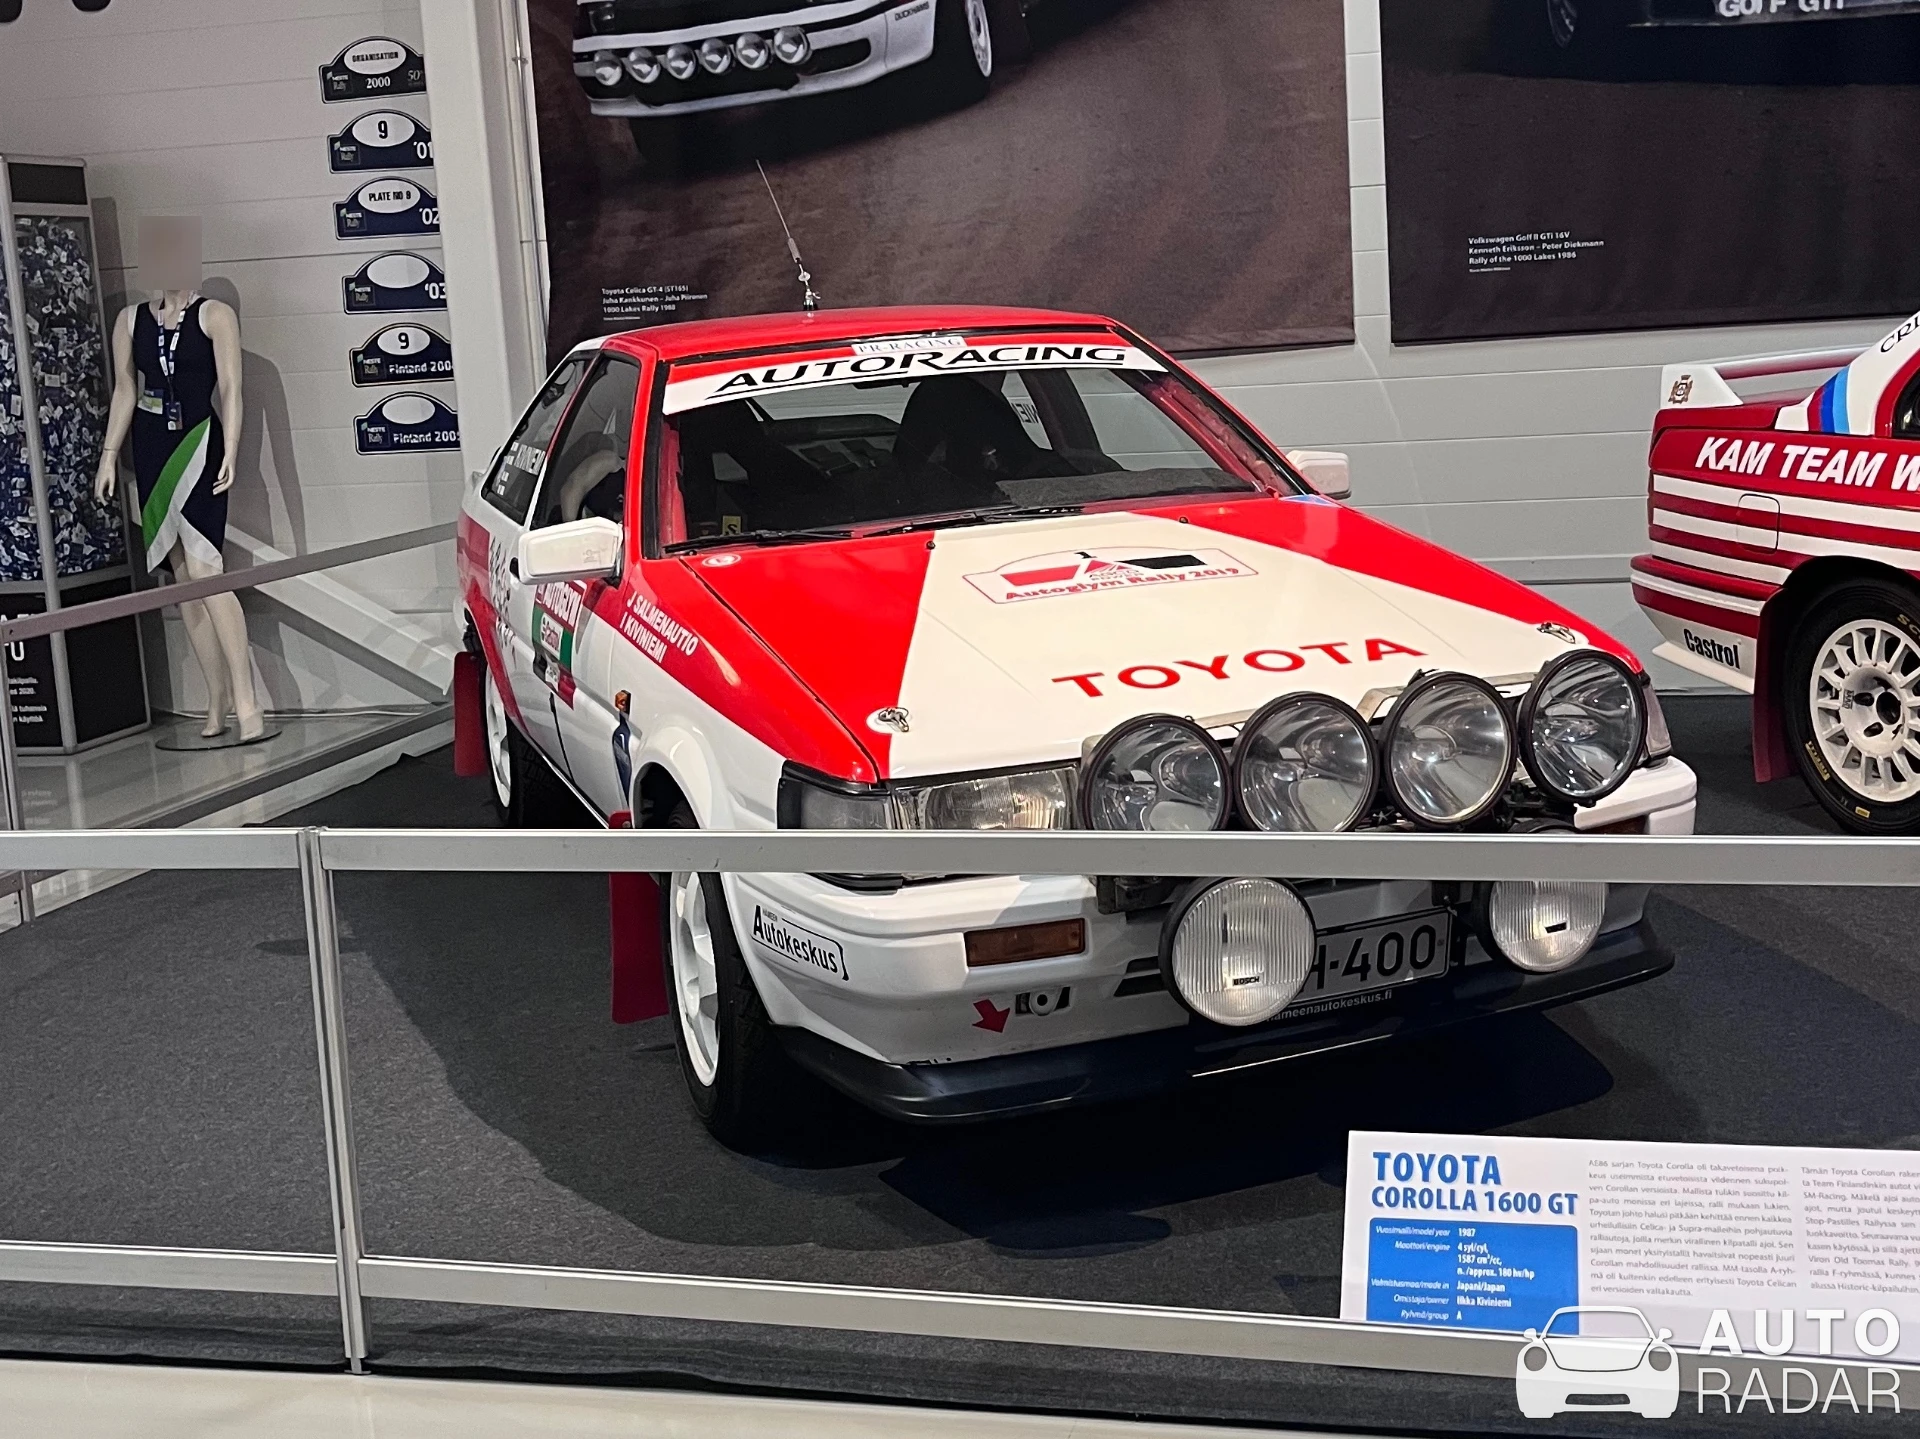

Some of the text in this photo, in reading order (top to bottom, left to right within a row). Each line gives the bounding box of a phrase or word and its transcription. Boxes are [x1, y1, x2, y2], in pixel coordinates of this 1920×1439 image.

[352, 52, 398, 62] ORGANISATION
[365, 76, 391, 89] 2000
[377, 120, 388, 139] 9
[368, 192, 390, 201] PLATE
[405, 191, 411, 200] 9
[1468, 236, 1514, 245] Volkswagen
[1515, 234, 1533, 242] Golf
[1555, 231, 1570, 240] 16V
[1468, 246, 1501, 255] Kenneth
[1502, 245, 1535, 253] Eriksson
[1542, 242, 1562, 251] Peter
[1564, 240, 1604, 249] Diekmann
[1469, 251, 1577, 266] Rally of the 1000 Lakes 1986
[602, 288, 624, 296] Toyota
[625, 287, 646, 296] Celica
[603, 297, 618, 305] Juha
[664, 295, 680, 303] Juha
[603, 306, 620, 314] 1000
[641, 305, 659, 313] Rally
[398, 332, 410, 349] 9
[389, 360, 454, 374] Finland 200
[714, 346, 1127, 393] AUTORACING
[393, 433, 431, 444] Finland
[1695, 436, 1775, 480] KAM
[1779, 444, 1888, 488] TEAM
[1005, 566, 1239, 600] Autoglym Rally 2019
[627, 590, 699, 656] J SALMENAUTIO
[624, 615, 668, 664] KIVINIEMI
[1683, 628, 1741, 670] Castrol
[1051, 637, 1429, 698] TOYOTA
[753, 904, 838, 974] Autokeskus
[1233, 976, 1260, 986] BOSCH
[1372, 1151, 1501, 1186] TOYOTA
[1588, 1159, 1608, 1168] AE86
[1638, 1161, 1664, 1171] Toyota
[1666, 1161, 1694, 1170] Corolla
[1696, 1162, 1707, 1170] oli
[1831, 1167, 1858, 1178] Toyota
[1861, 1168, 1896, 1177] Corollan
[1605, 1184, 1638, 1192] Corollan
[1813, 1179, 1834, 1187] Team
[1371, 1186, 1578, 1215] COROLLA 1600 GT
[1623, 1197, 1656, 1206] monissa
[1708, 1200, 1724, 1208] ralli
[1727, 1200, 1760, 1209] mukaan
[1589, 1208, 1621, 1219] Toyotan
[1622, 1209, 1643, 1219] johto
[1644, 1210, 1668, 1219] halusi
[1435, 1229, 1451, 1238] year
[1458, 1227, 1476, 1237] 1987
[1668, 1224, 1676, 1234] ja
[1457, 1242, 1463, 1251] 4
[1778, 1240, 1794, 1249] Sen
[1872, 1245, 1880, 1255] ja
[1457, 1254, 1476, 1264] 1587
[1590, 1259, 1623, 1268] Corollan
[1834, 1256, 1849, 1265] Old
[1498, 1267, 1512, 1277] 180
[1512, 1267, 1535, 1280] hv/hp
[1606, 1272, 1616, 1280] oli
[1737, 1277, 1764, 1288] Toyota
[1442, 1281, 1450, 1289] in
[1456, 1280, 1506, 1293] Japani/Japan
[1393, 1294, 1512, 1307] Omistaja/owner Ilkka Kiviniemi
[1456, 1310, 1463, 1321] A
